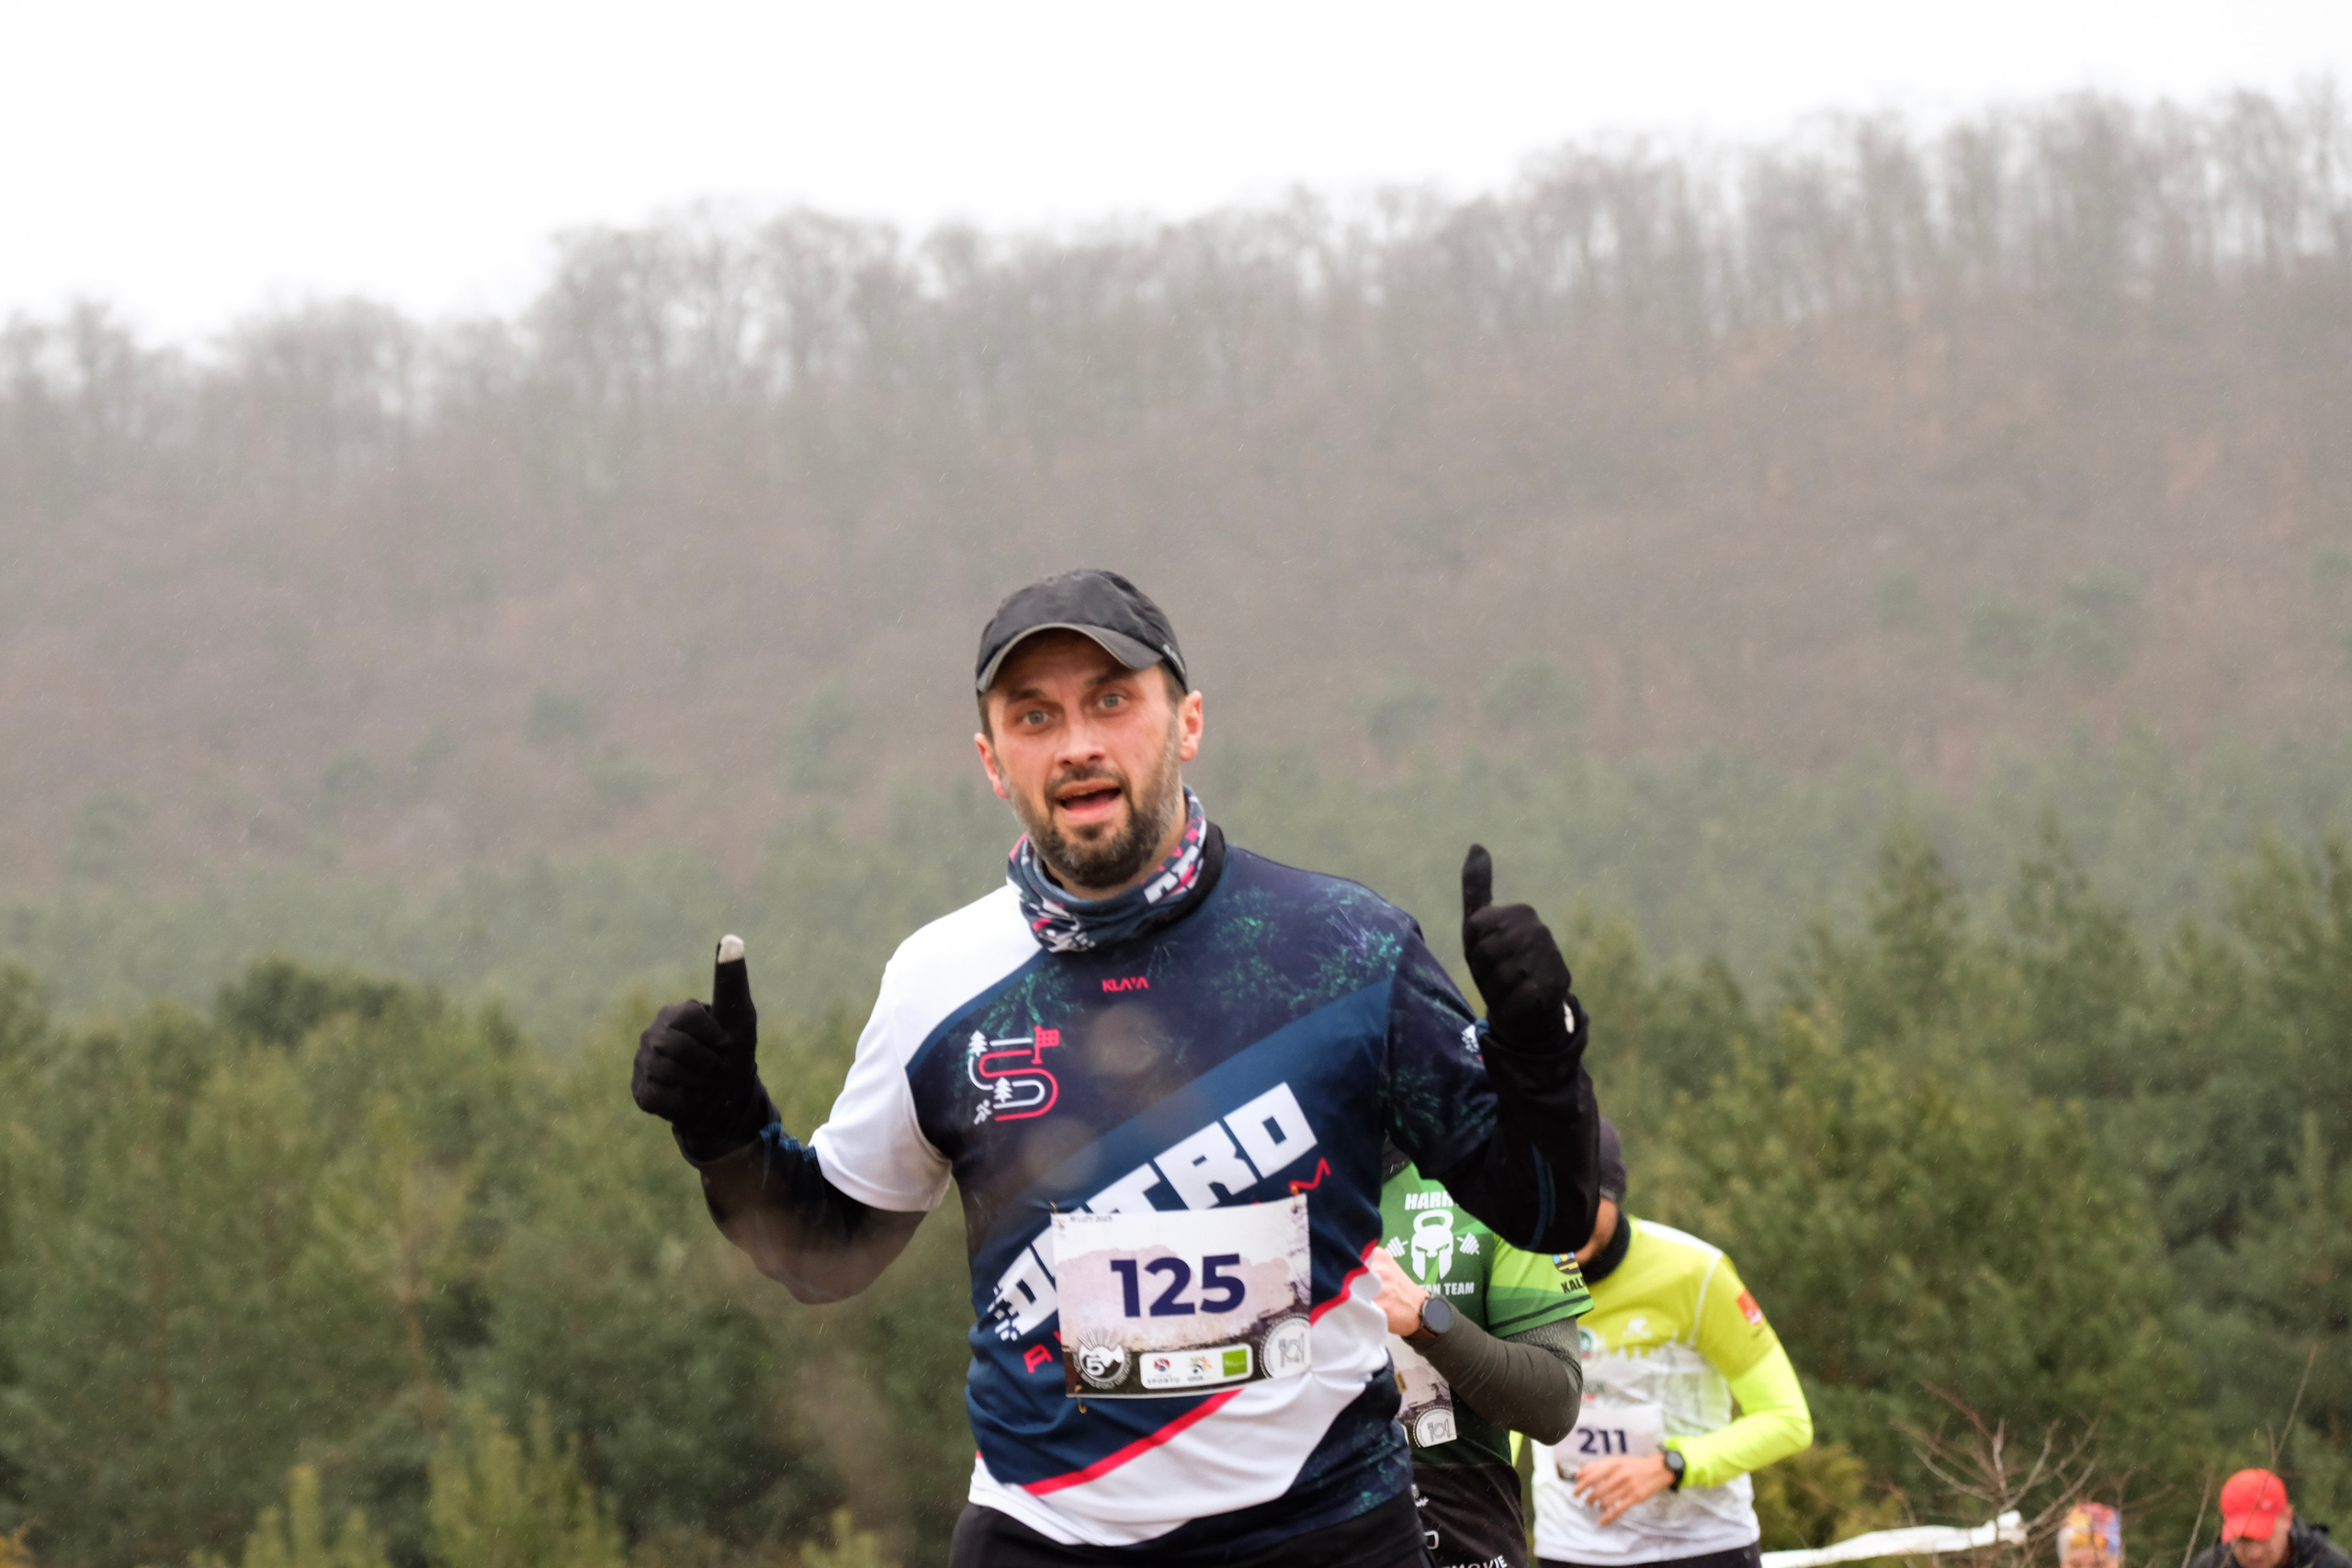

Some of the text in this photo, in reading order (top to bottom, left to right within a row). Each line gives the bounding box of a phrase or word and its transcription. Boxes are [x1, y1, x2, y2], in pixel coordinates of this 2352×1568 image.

[1110, 1253, 1246, 1318] 125
[1443, 1281, 1476, 1296] TEAM
[1577, 1427, 1628, 1455] 211
